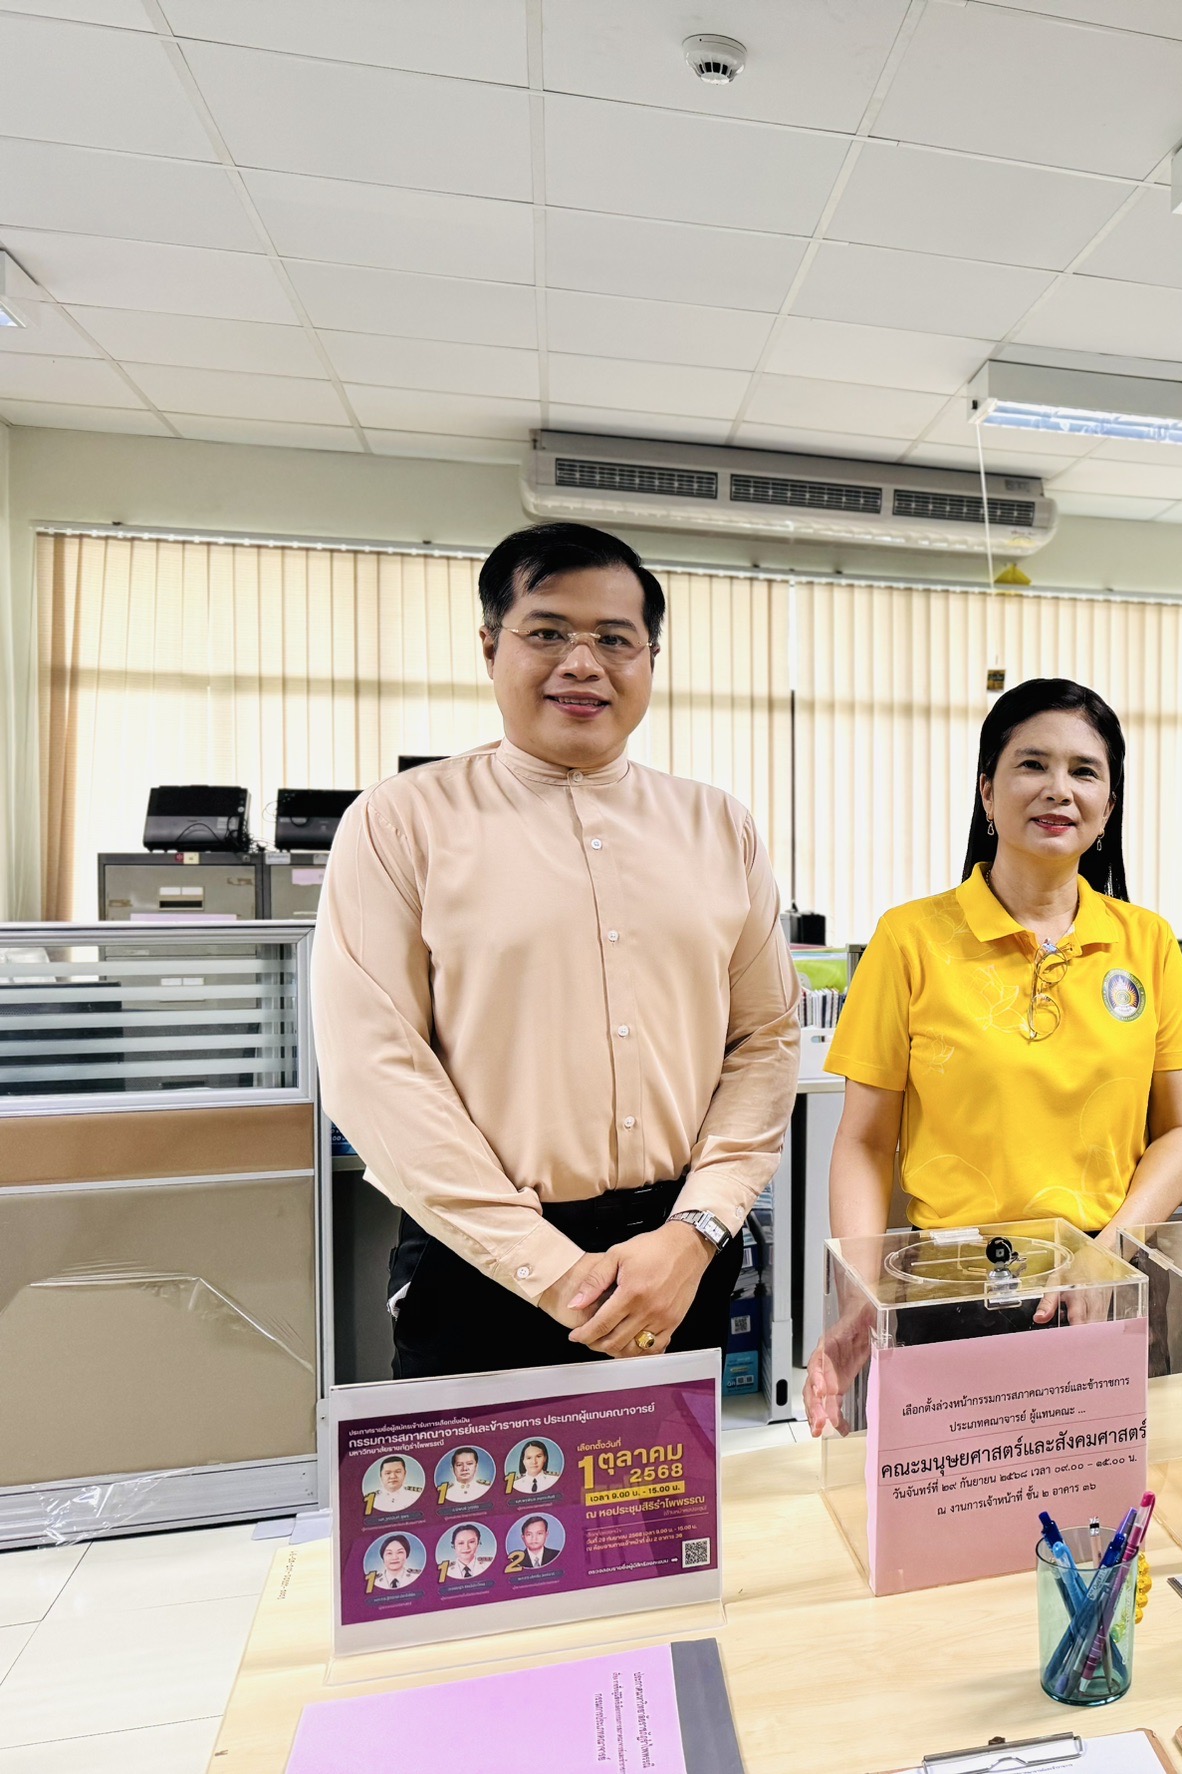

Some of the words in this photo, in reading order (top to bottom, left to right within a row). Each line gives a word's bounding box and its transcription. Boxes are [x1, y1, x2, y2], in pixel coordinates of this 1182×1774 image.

[902, 1376, 1130, 1417] เลือกตั้งล่วงหน้ากรรมการสภาคณาจารย์และข้าราชการ
[348, 1417, 541, 1448] กรรมการสภาคณาจารย์และข้าราชการ
[543, 1402, 655, 1424] ประเภทผู้แทนคณาจารย์
[950, 1410, 1026, 1433] ประเภทคณาจารย์
[1030, 1406, 1075, 1425] ผู้แทนคณะ
[577, 1437, 621, 1451] เลือกตั้งวันที่
[882, 1420, 1147, 1478] คณะมนุษยศาสตร์และสังคมศาสตร์
[578, 1455, 593, 1489] 1
[598, 1443, 682, 1475] ตุลาคม
[630, 1463, 682, 1483] 2568
[893, 1482, 938, 1499] วันจันทร์ที่
[942, 1481, 956, 1492] ๒๙
[960, 1473, 996, 1489] กันยายน
[1031, 1465, 1050, 1478] เวลา
[1128, 1454, 1137, 1463] น.
[649, 1486, 669, 1494] 15.00
[937, 1505, 946, 1515] ณ
[950, 1490, 1023, 1514] งานการเจ้าหน้าที่
[1027, 1483, 1039, 1501] ชั้น
[1053, 1483, 1079, 1497] อาคาร
[504, 1550, 525, 1574] 2
